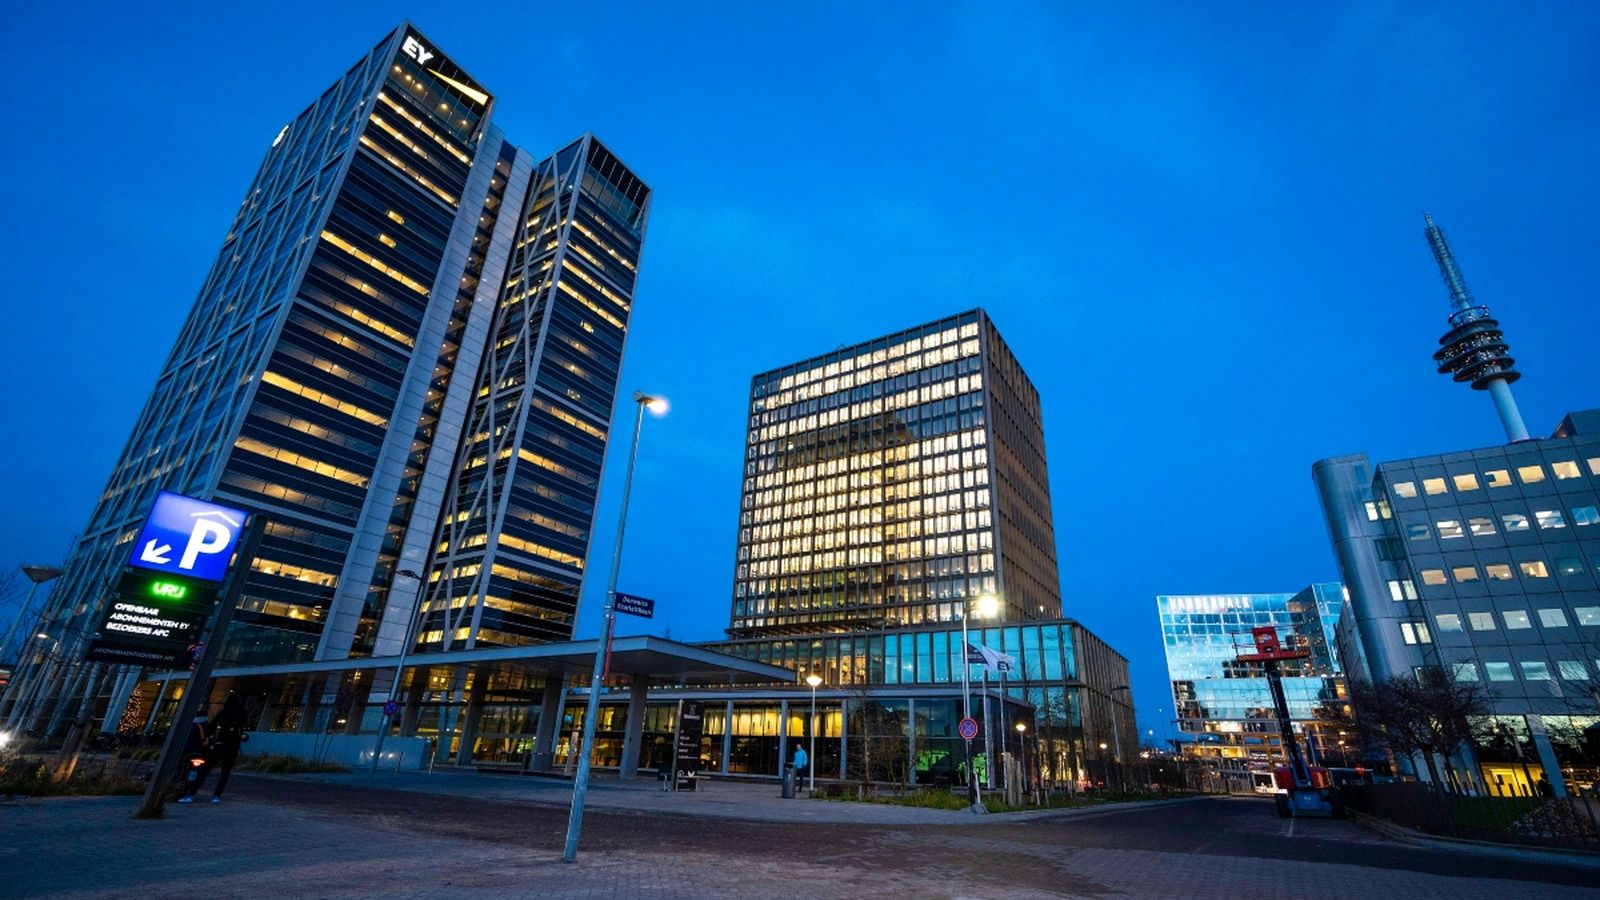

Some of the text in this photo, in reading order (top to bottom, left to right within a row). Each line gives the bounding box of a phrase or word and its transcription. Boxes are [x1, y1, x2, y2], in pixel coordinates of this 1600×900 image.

[402, 35, 434, 65] EY
[179, 518, 231, 570] P
[115, 603, 159, 615] OPENBAAR
[106, 622, 152, 634] BEZOEKERS
[110, 613, 178, 628] ABONNEMENTEN
